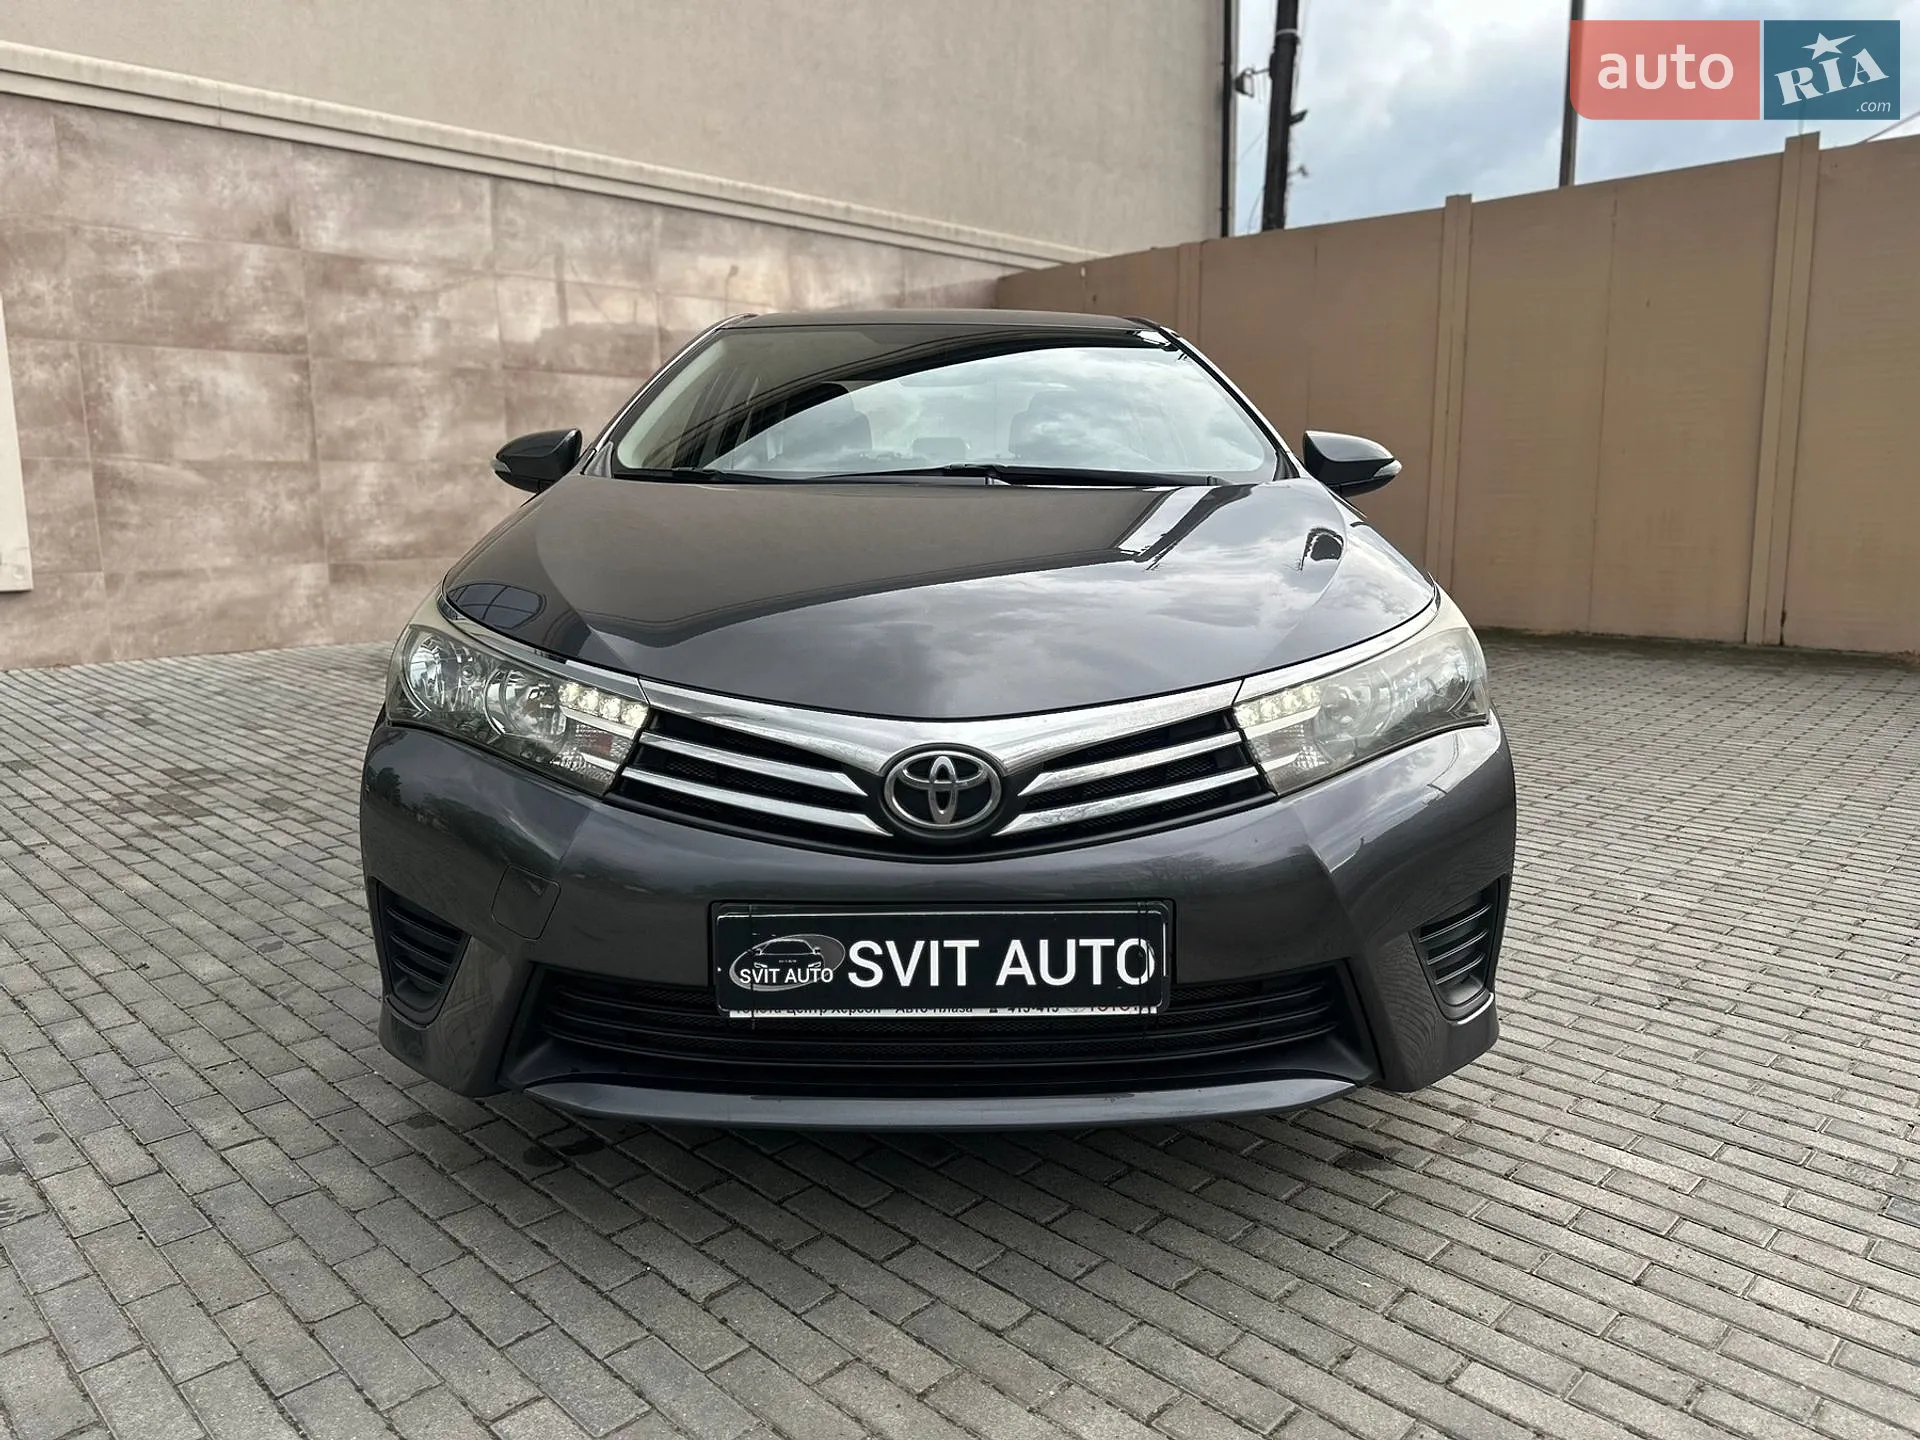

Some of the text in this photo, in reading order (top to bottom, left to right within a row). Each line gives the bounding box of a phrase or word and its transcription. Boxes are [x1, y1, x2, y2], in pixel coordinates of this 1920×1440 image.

[740, 967, 834, 984] SVIT AUTO
[847, 938, 1156, 988] SVIT AUTO
